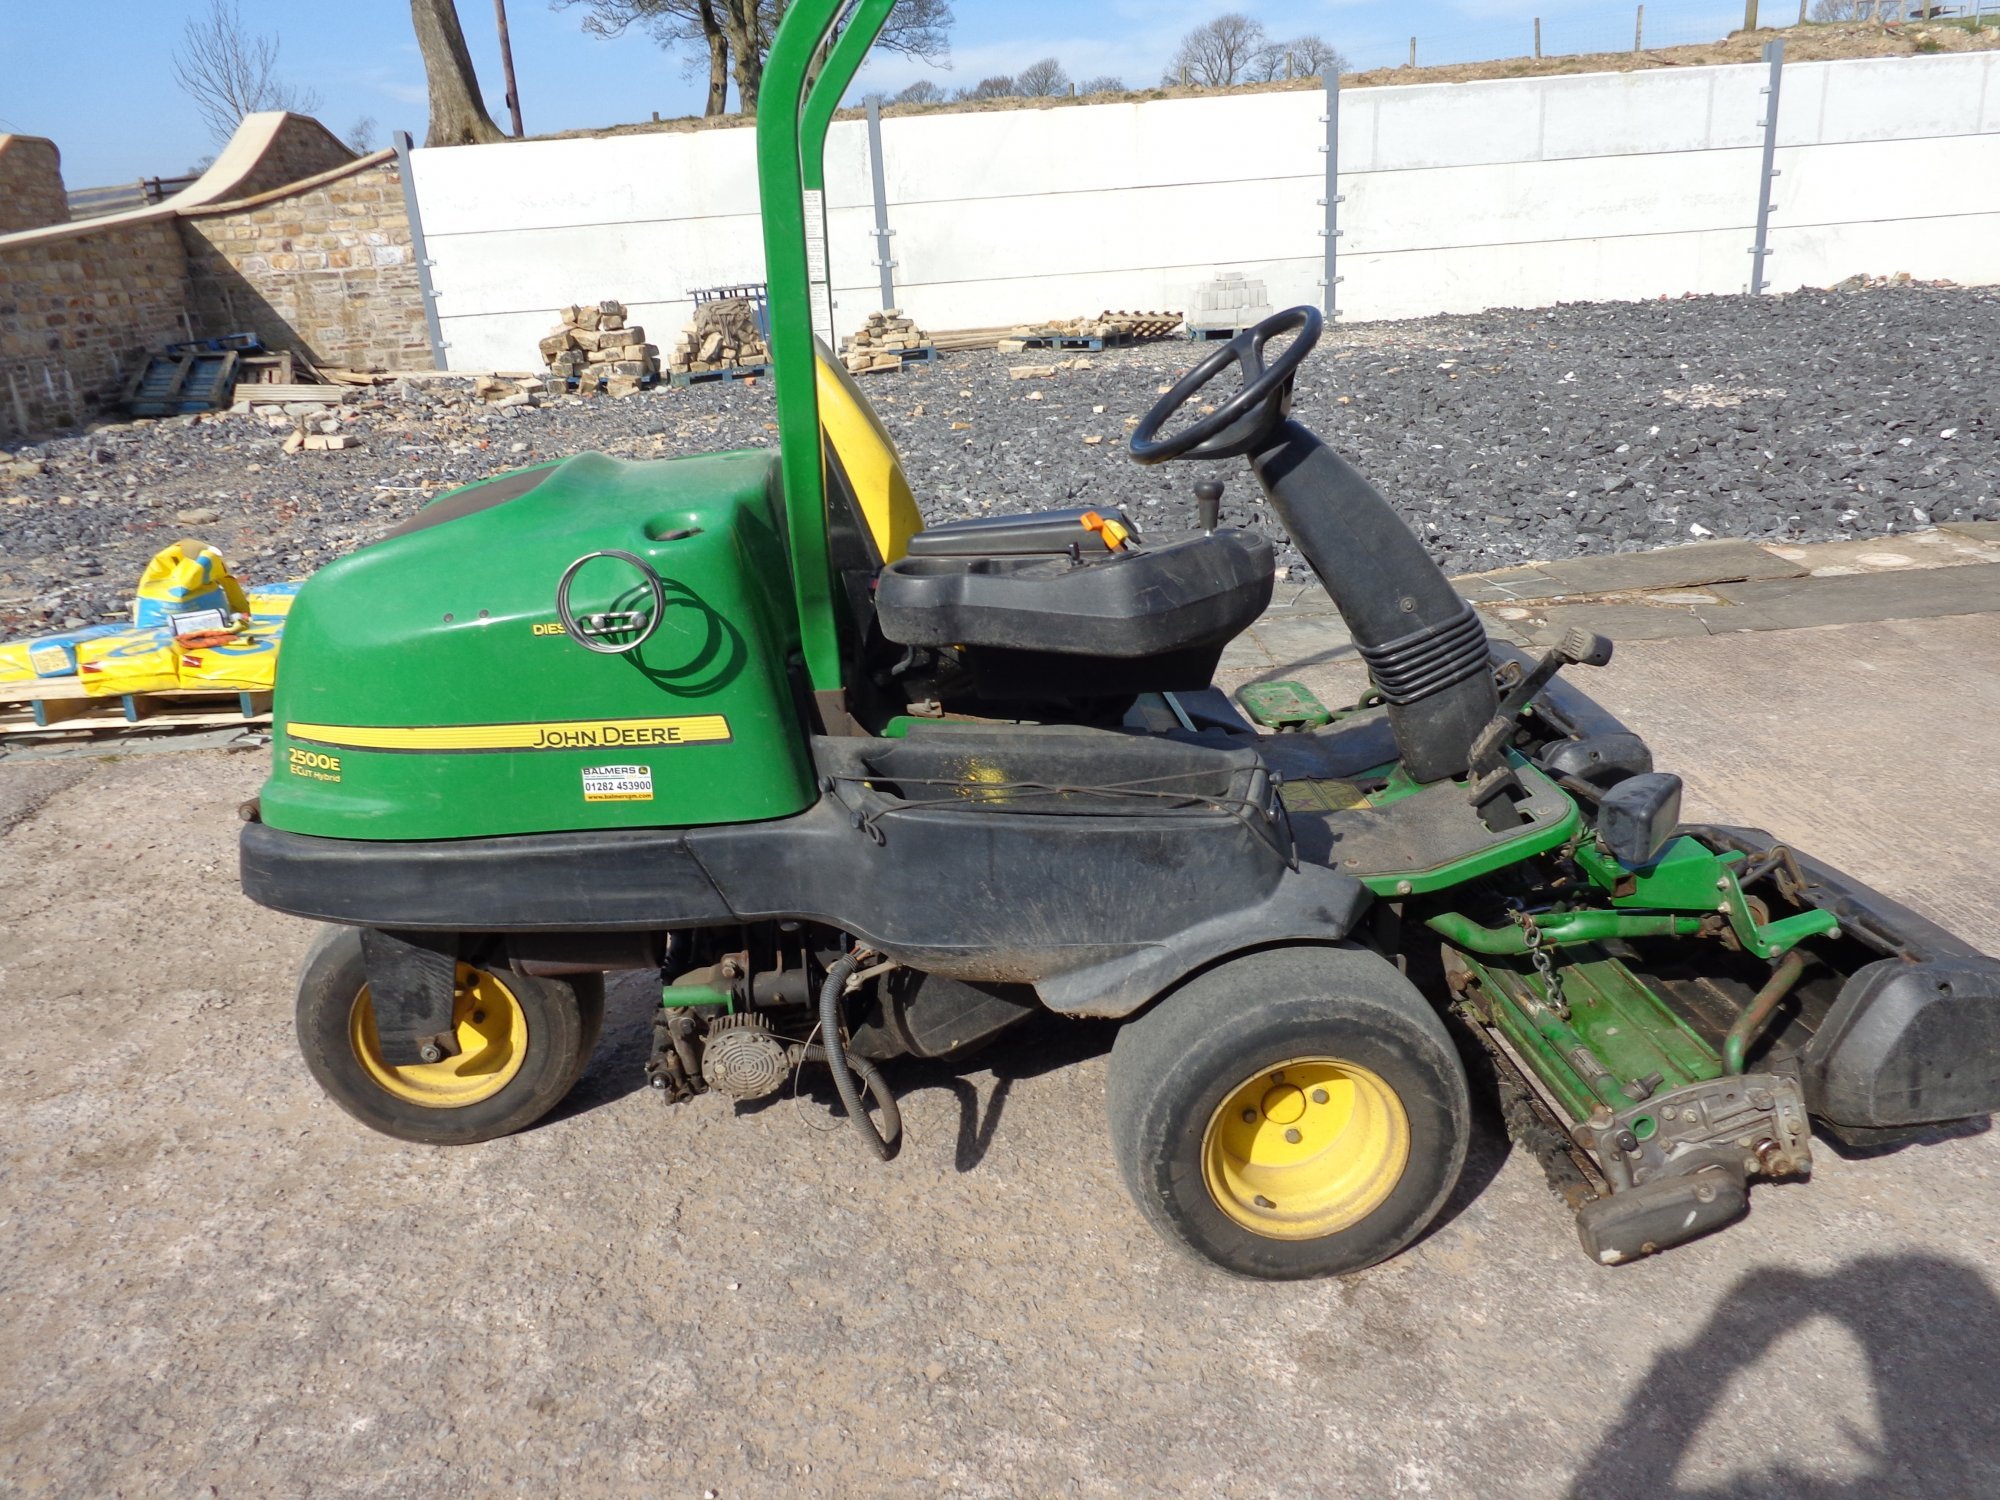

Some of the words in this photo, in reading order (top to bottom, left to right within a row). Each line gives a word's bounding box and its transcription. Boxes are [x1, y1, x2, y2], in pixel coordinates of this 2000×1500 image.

[532, 623, 567, 636] DIES
[533, 729, 596, 746] JOHN
[603, 727, 681, 744] DEERE
[289, 747, 341, 771] 2500E
[583, 767, 636, 775] BALMERS
[585, 782, 614, 791] 01282
[617, 781, 651, 790] 453900
